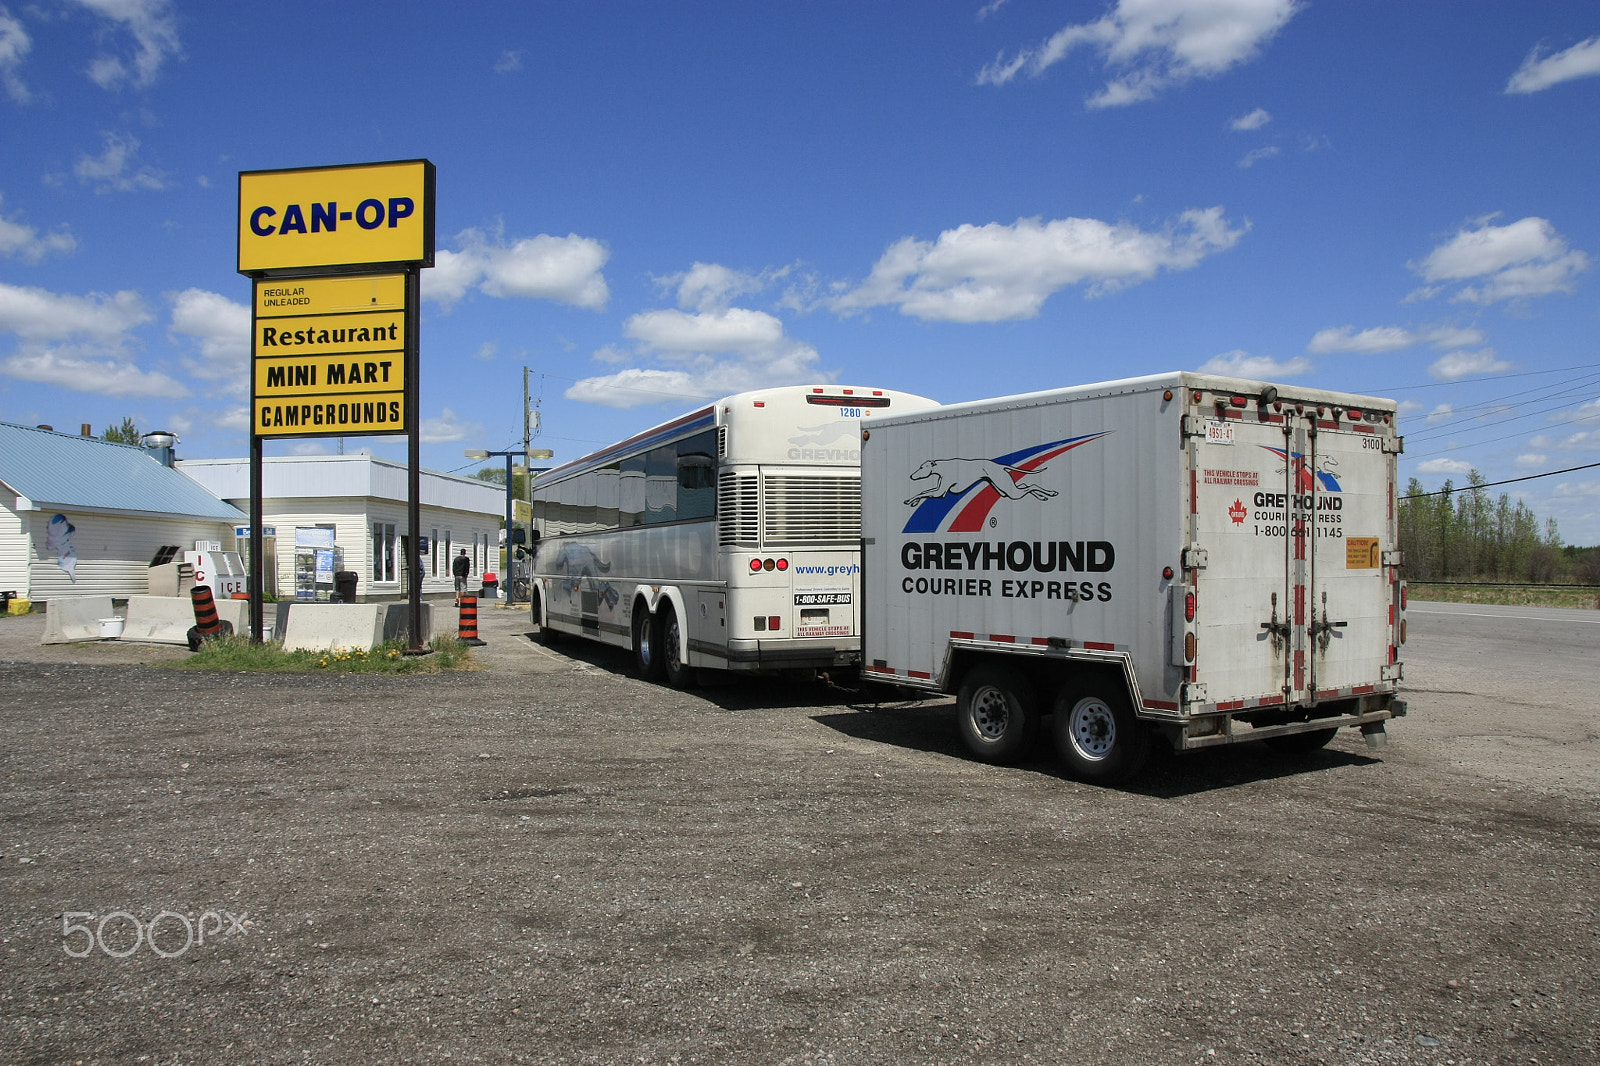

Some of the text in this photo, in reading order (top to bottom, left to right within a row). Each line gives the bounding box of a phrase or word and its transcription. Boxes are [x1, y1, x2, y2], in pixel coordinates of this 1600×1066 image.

[250, 197, 414, 236] CAN-OP
[263, 288, 305, 297] REGULAR
[263, 297, 310, 307] UNLEADED
[262, 323, 398, 347] Restaurant
[267, 361, 392, 387] MINI MART
[261, 401, 400, 427] CAMPGROUNDS
[840, 407, 861, 418] 1280
[1362, 438, 1380, 450] 3100
[1204, 469, 1215, 477] THIS
[1216, 470, 1236, 478] VEHICLE
[1236, 471, 1252, 479] STOPS
[1234, 479, 1259, 487] CROSSINGS
[1254, 511, 1298, 521] COURIR
[1301, 513, 1342, 523] EXRESS
[901, 541, 1115, 573] GREYHOUND
[795, 564, 860, 576] www.greyh
[221, 581, 242, 593] ICE
[901, 577, 1112, 602] COURIER EXPRESS
[795, 594, 851, 604] 1-800-SAFE-BUS
